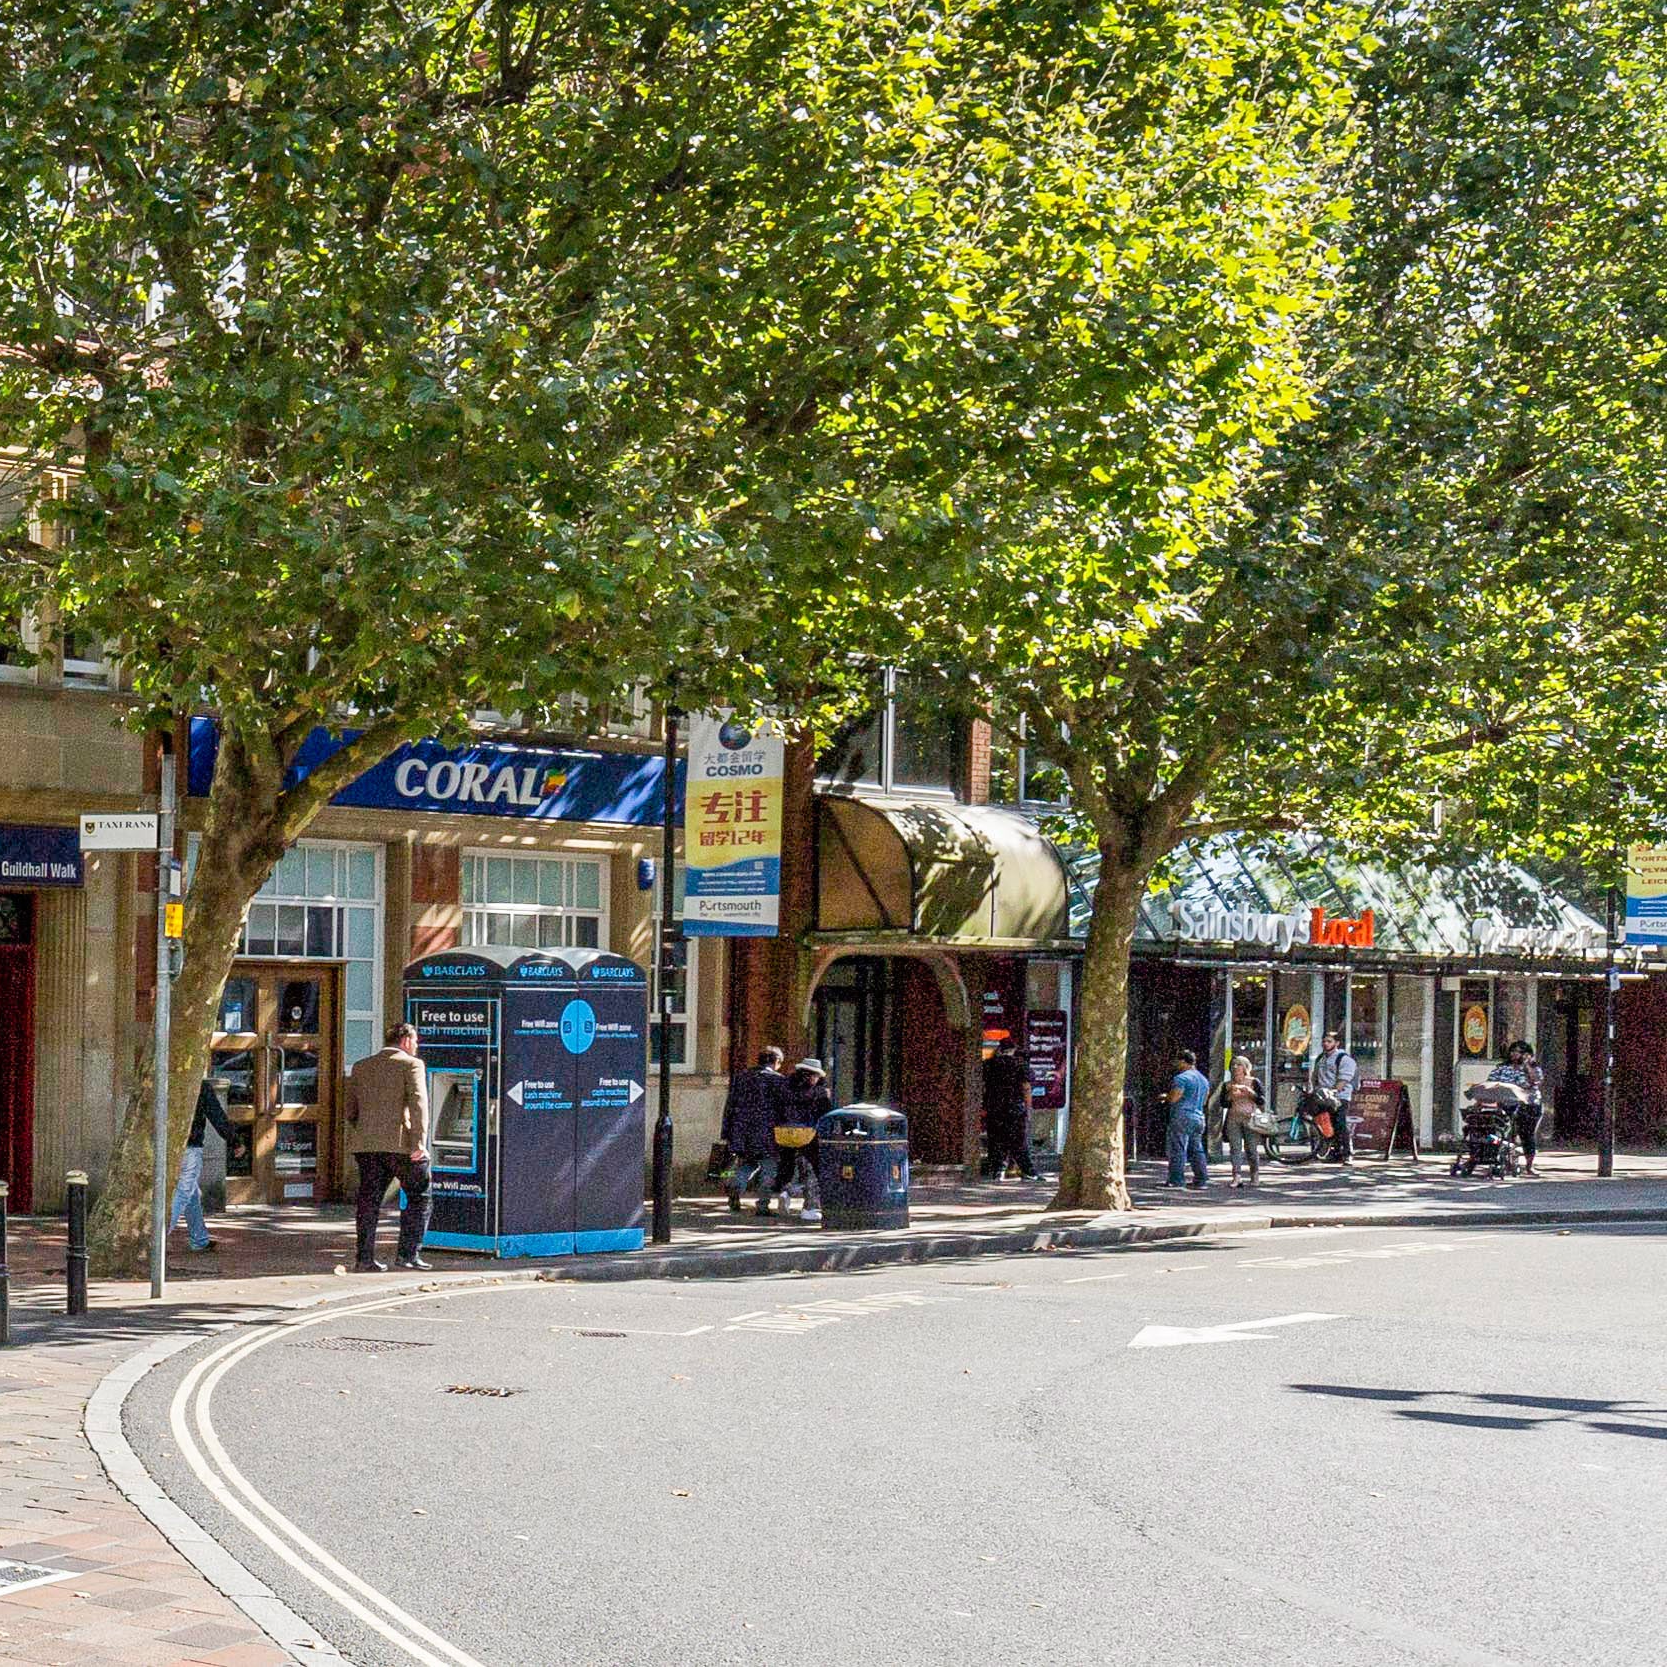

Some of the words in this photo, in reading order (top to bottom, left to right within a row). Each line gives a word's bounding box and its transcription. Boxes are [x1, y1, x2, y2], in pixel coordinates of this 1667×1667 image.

[706, 764, 763, 777] COSMO
[395, 758, 542, 805] CORAL
[700, 789, 768, 824] 专注
[98, 821, 123, 829] TAXI
[125, 820, 155, 829] RANK
[1, 860, 48, 877] Guildhall
[50, 862, 77, 878] Walk
[699, 900, 762, 911] Portsmouth
[1173, 899, 1313, 954] Sainsbury's
[1311, 907, 1375, 947] Local
[434, 965, 486, 975] BARCLAYS
[528, 966, 564, 976] BARCLAYS
[600, 967, 636, 978] BARCLAYS
[421, 1010, 447, 1022] Free
[449, 1010, 461, 1022] to
[463, 1012, 485, 1022] use
[521, 1019, 534, 1028] Free
[595, 1022, 607, 1031] Free
[419, 1023, 440, 1035] ash
[442, 1023, 491, 1036] machine
[524, 1080, 537, 1089] Free
[537, 1081, 545, 1089] to
[599, 1077, 612, 1086] Free
